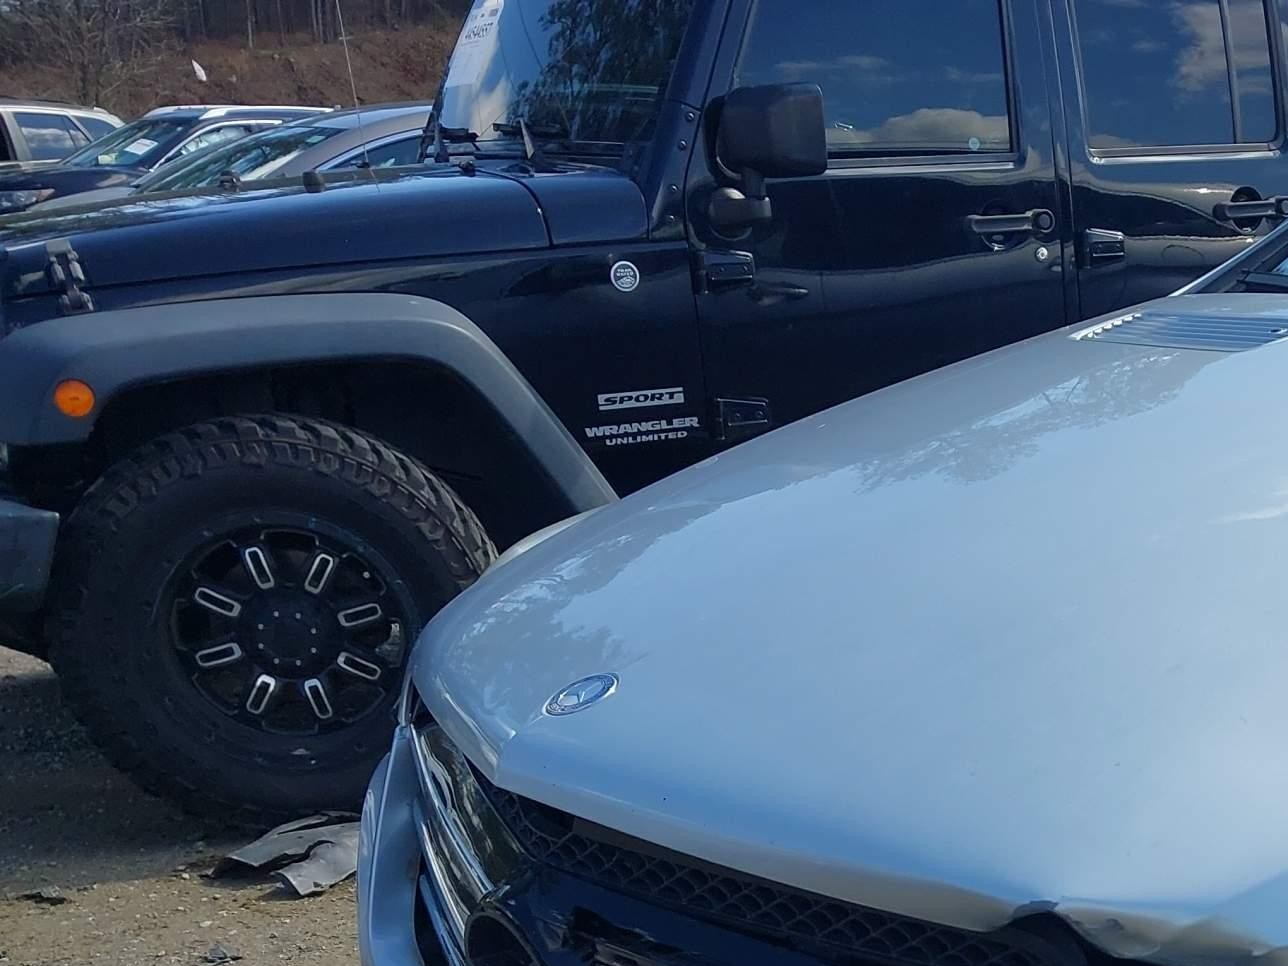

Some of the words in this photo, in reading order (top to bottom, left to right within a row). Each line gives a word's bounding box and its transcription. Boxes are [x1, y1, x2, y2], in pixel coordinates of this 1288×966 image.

[602, 390, 679, 406] SPORT
[585, 416, 701, 438] WRANGLER
[605, 430, 688, 446] UNLIMITED
